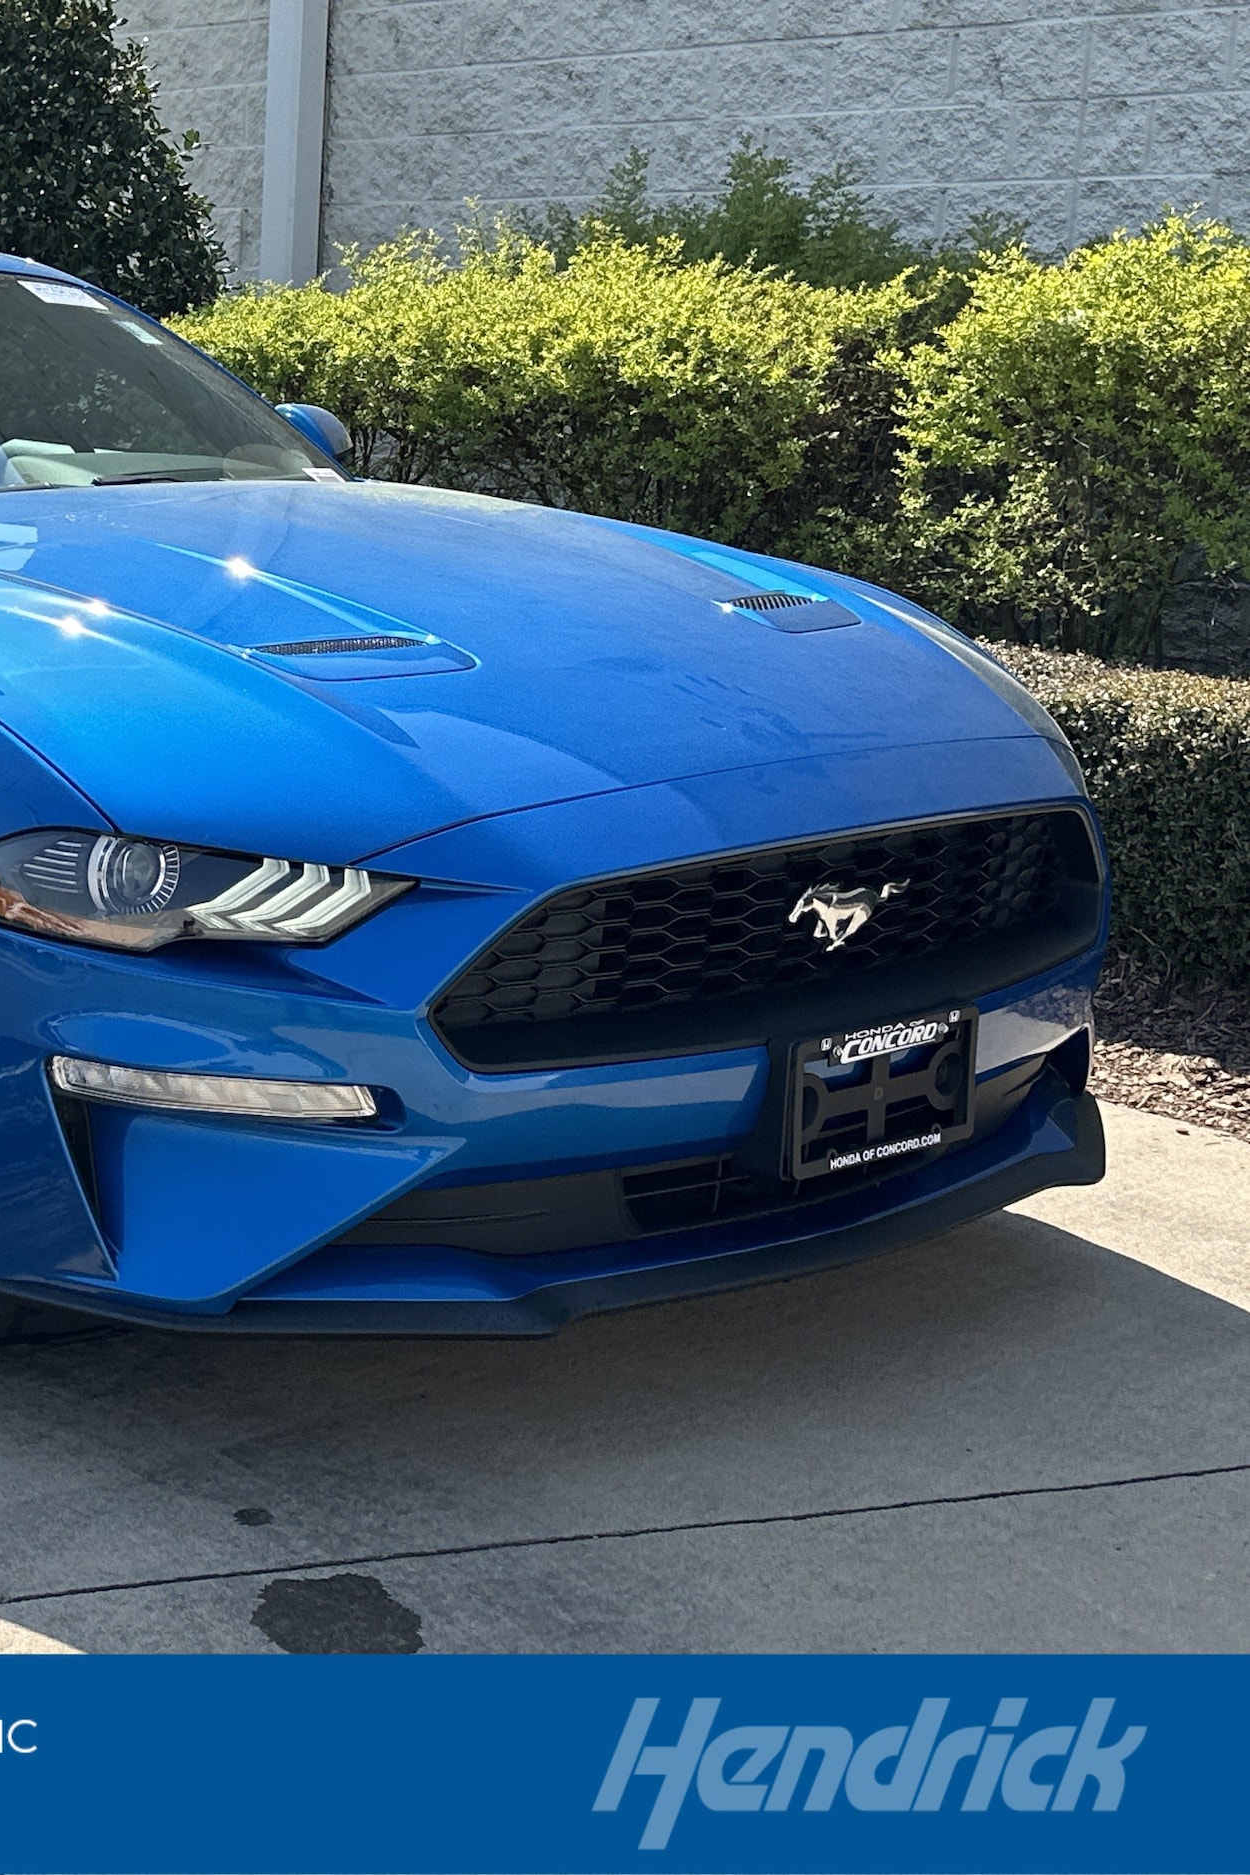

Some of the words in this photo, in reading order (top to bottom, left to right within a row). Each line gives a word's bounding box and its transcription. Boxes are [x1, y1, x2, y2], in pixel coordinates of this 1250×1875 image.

[839, 1022, 938, 1064] CONCORD
[845, 1022, 906, 1042] HONDA
[830, 1152, 861, 1170] HONDA
[862, 1148, 876, 1161] OF
[876, 1132, 941, 1158] CONCORD.COM
